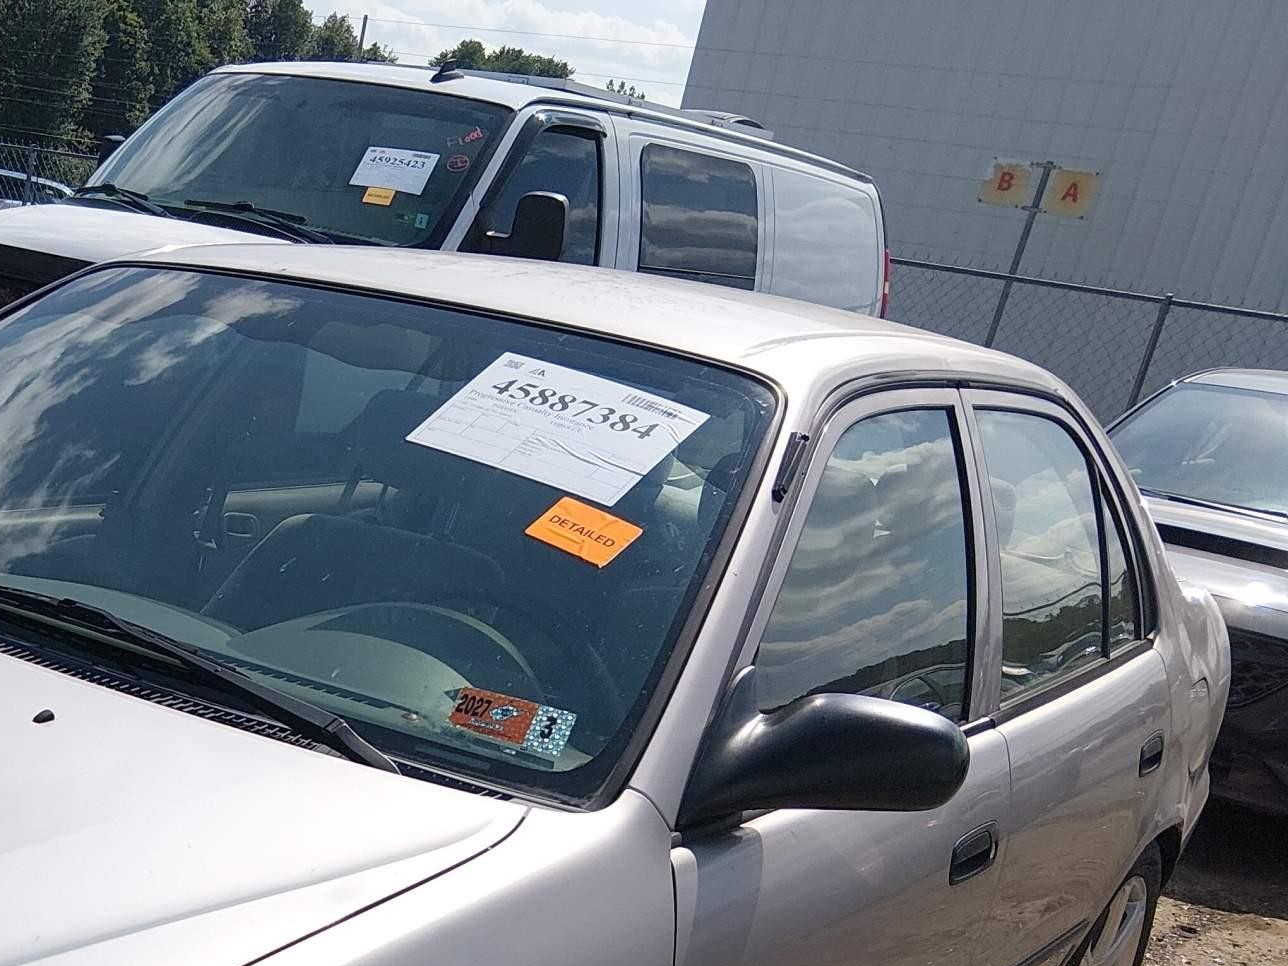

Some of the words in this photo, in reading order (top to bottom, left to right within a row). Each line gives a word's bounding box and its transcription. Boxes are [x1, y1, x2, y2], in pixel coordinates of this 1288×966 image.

[369, 155, 426, 170] 45925423
[997, 172, 1014, 191] B
[1061, 182, 1080, 203] A
[492, 379, 661, 440] 45887384
[548, 513, 616, 549] DETAILED
[455, 694, 493, 718] 2027
[539, 716, 559, 739] 3
